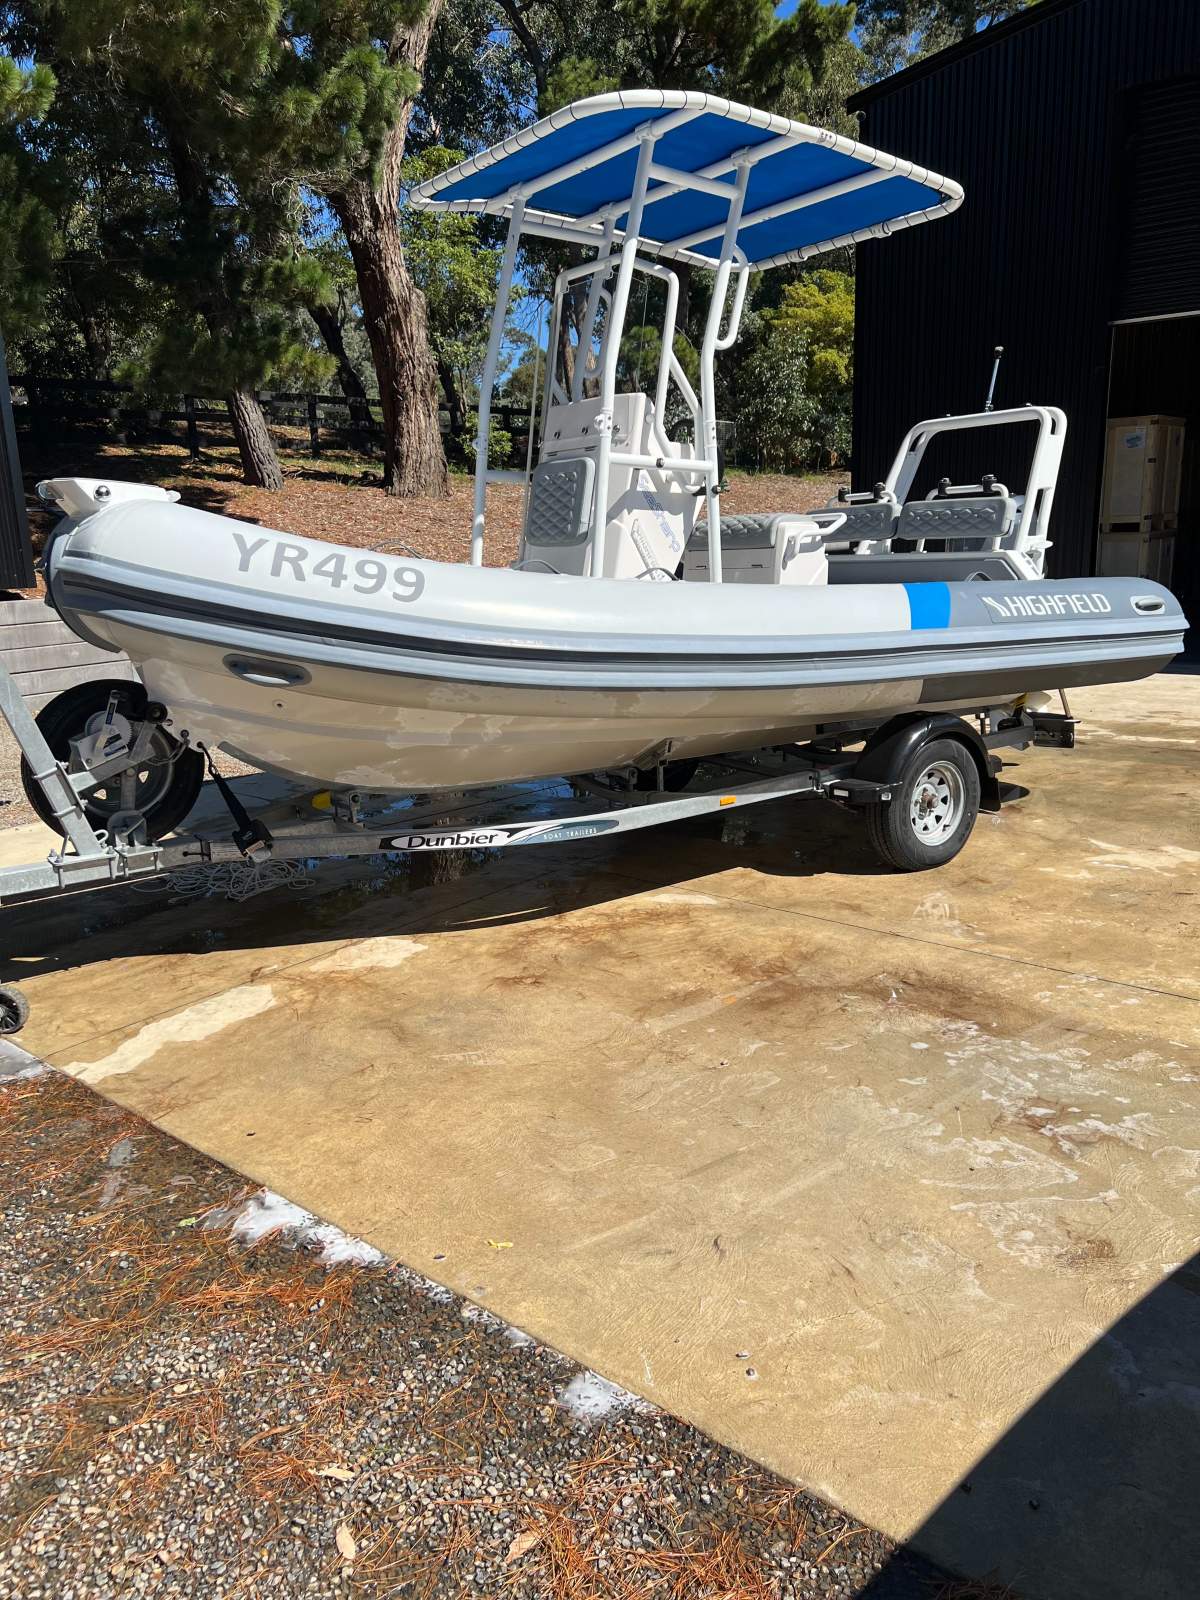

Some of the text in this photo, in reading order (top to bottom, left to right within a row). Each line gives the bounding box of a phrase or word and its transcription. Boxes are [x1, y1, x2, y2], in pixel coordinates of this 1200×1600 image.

[232, 533, 426, 603] YR499
[1004, 593, 1112, 617] HIGHFIELD
[407, 833, 499, 848] Dunbier
[543, 827, 597, 840] BOAT TRAILERS
